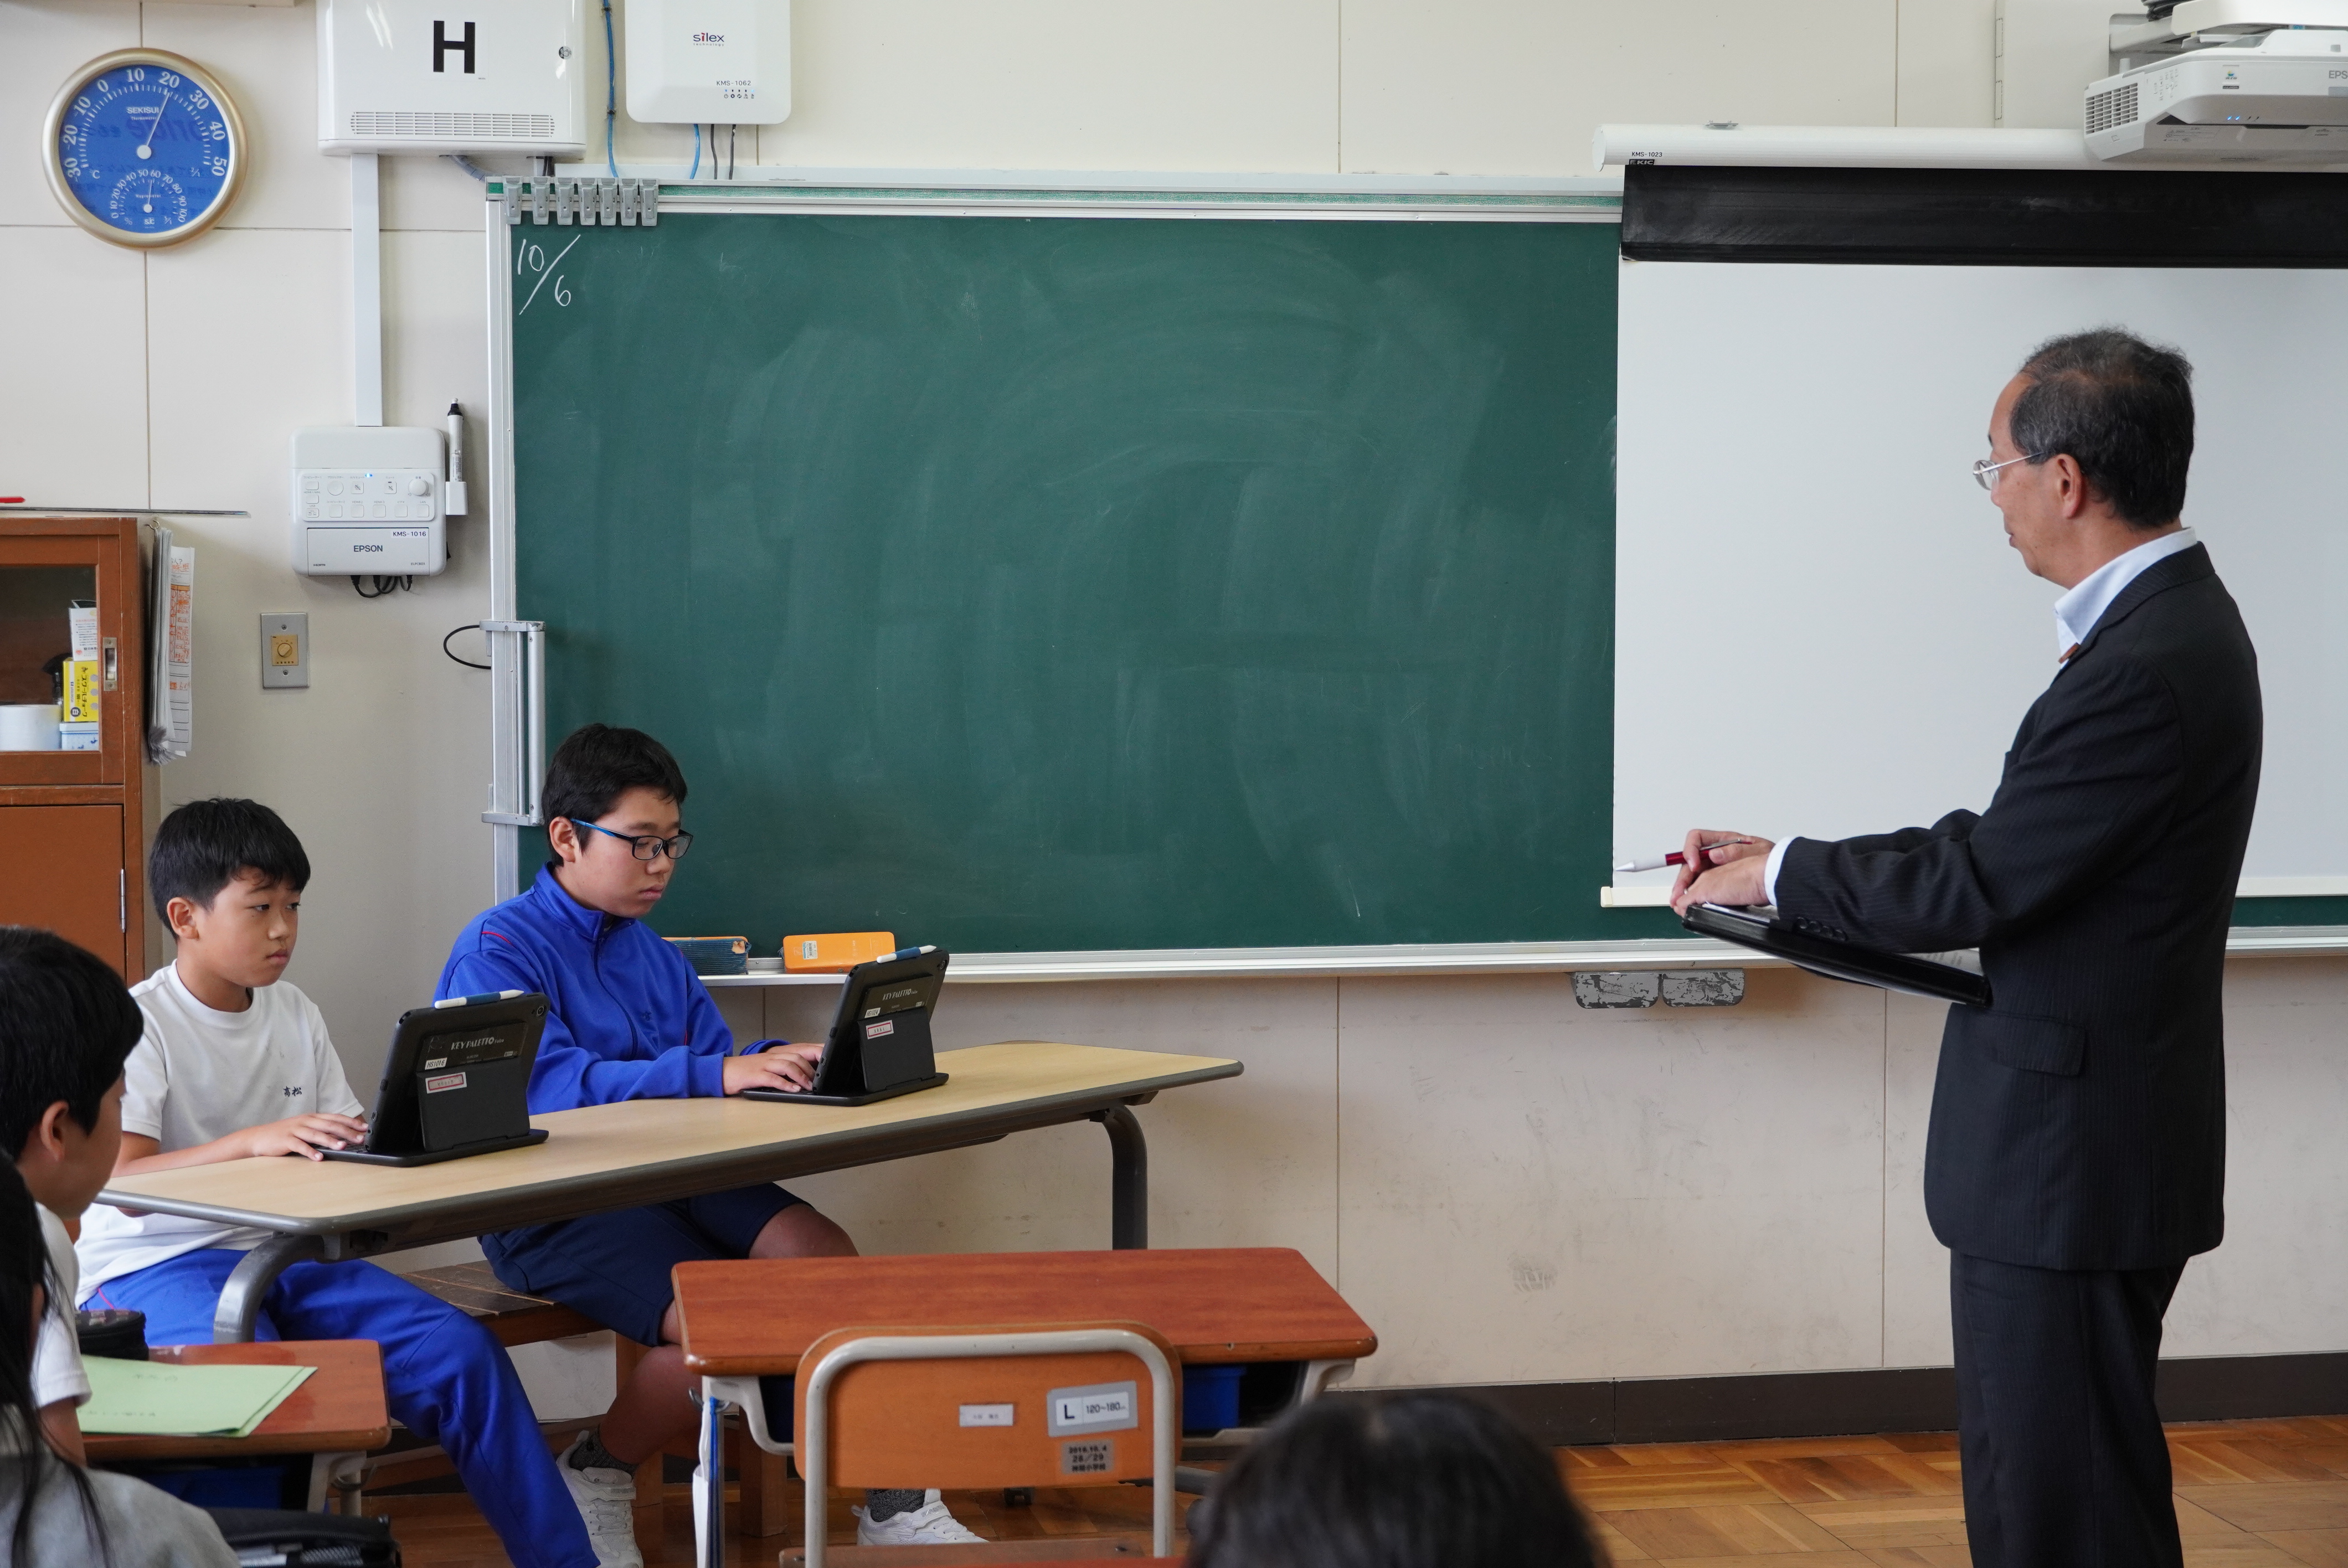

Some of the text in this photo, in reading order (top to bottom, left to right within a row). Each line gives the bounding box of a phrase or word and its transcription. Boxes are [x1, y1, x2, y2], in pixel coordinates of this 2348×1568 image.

[693, 33, 724, 42] silex
[434, 20, 475, 74] H
[126, 68, 145, 82] 10
[158, 71, 180, 88] 20
[2329, 70, 2348, 79] EPS
[97, 79, 109, 92] 0
[189, 90, 209, 110] 30
[210, 121, 226, 141] 40
[212, 157, 228, 176] 50
[126, 172, 136, 181] 40
[163, 174, 173, 184] 70
[117, 180, 126, 189] 30
[172, 183, 182, 194] 80
[112, 189, 121, 199] 20
[110, 201, 117, 209] 10
[178, 196, 187, 207] 90
[178, 208, 187, 222] 100
[426, 1060, 445, 1068] HS1016
[1064, 1404, 1075, 1420] L
